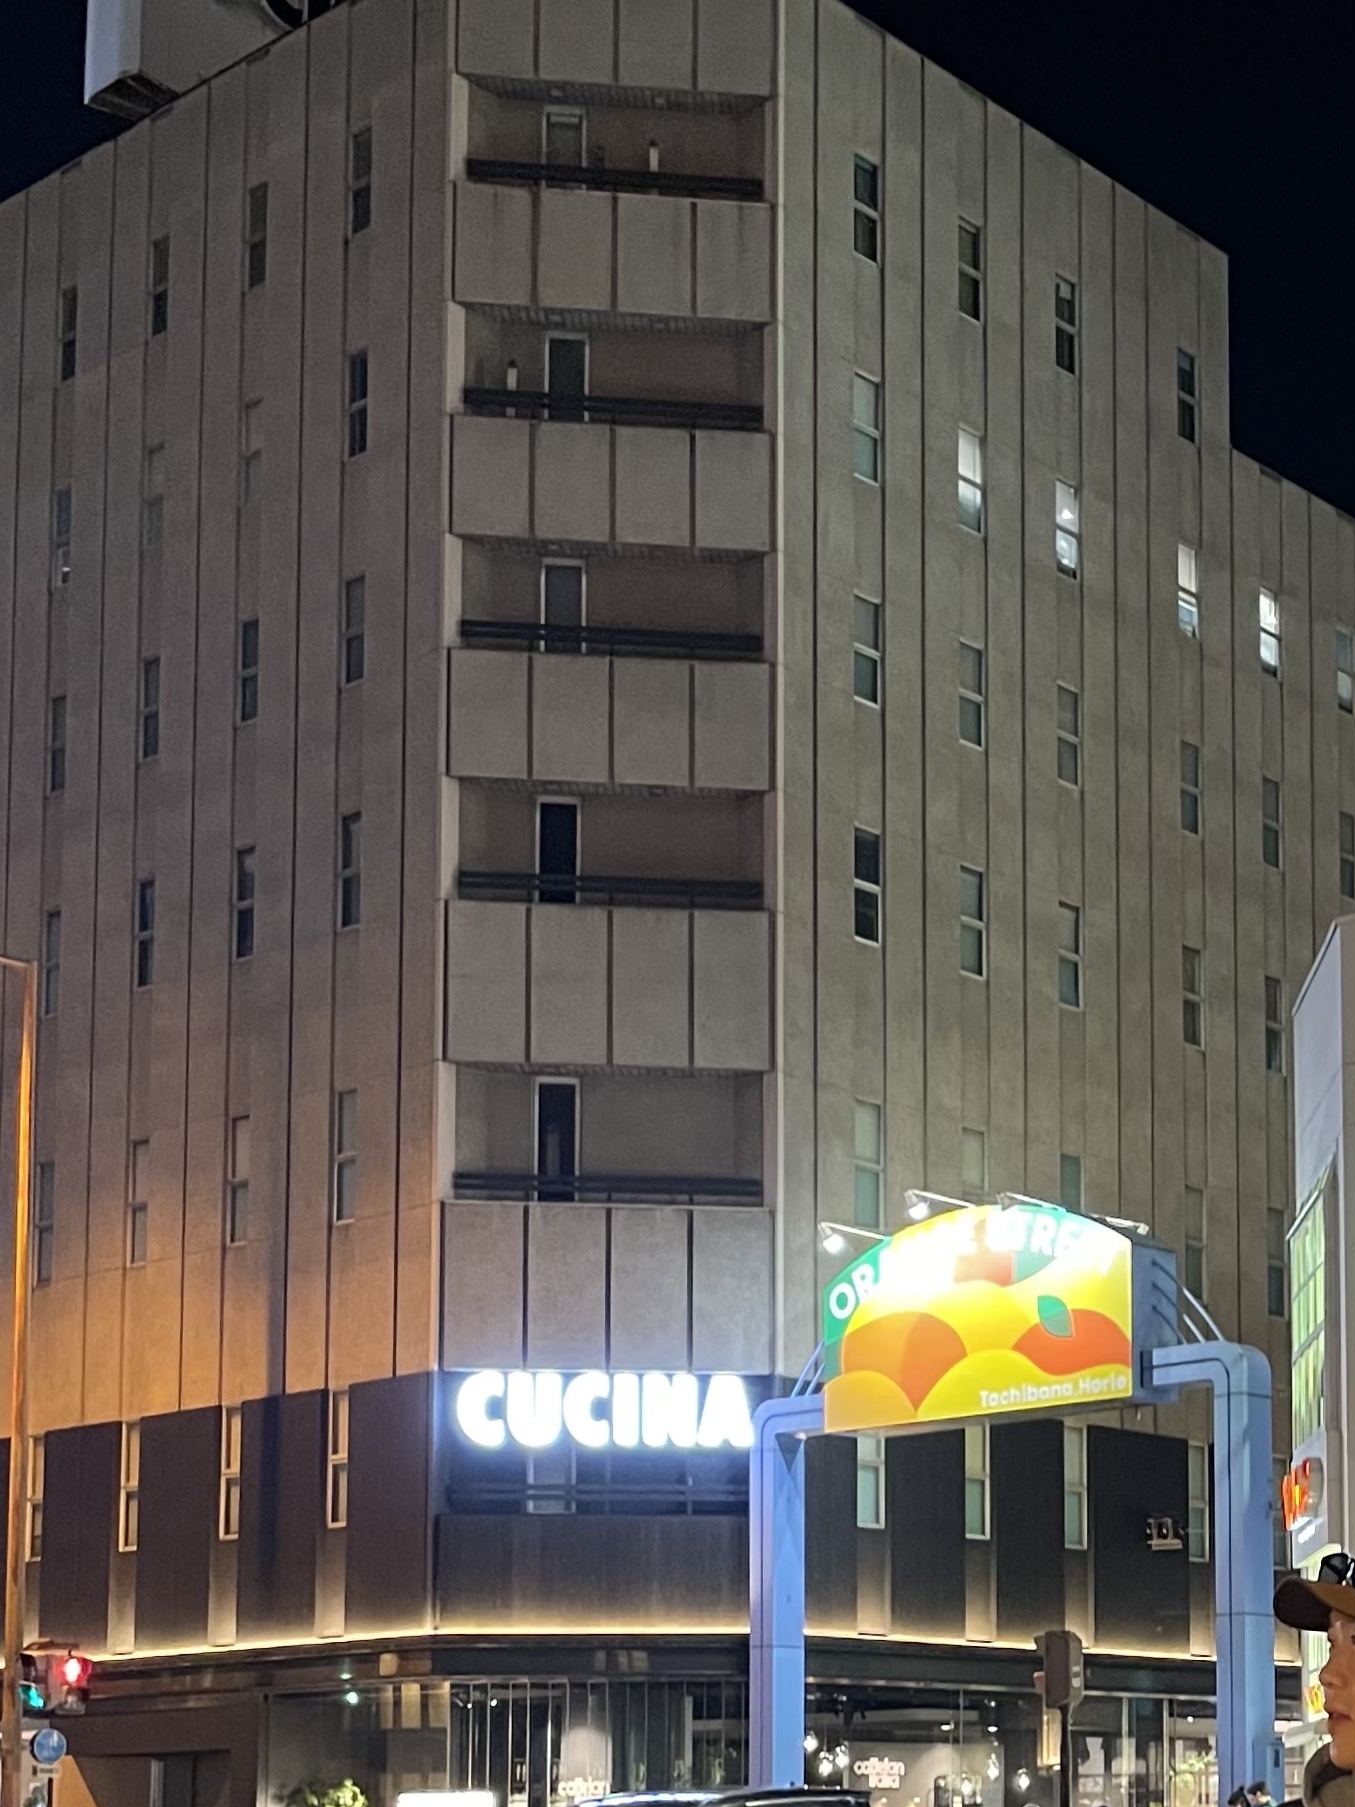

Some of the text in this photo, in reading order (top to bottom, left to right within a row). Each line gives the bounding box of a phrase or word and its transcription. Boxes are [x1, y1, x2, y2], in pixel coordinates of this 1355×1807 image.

[456, 1369, 755, 1449] CUCINA
[980, 1371, 1127, 1408] Tachibana Horie
